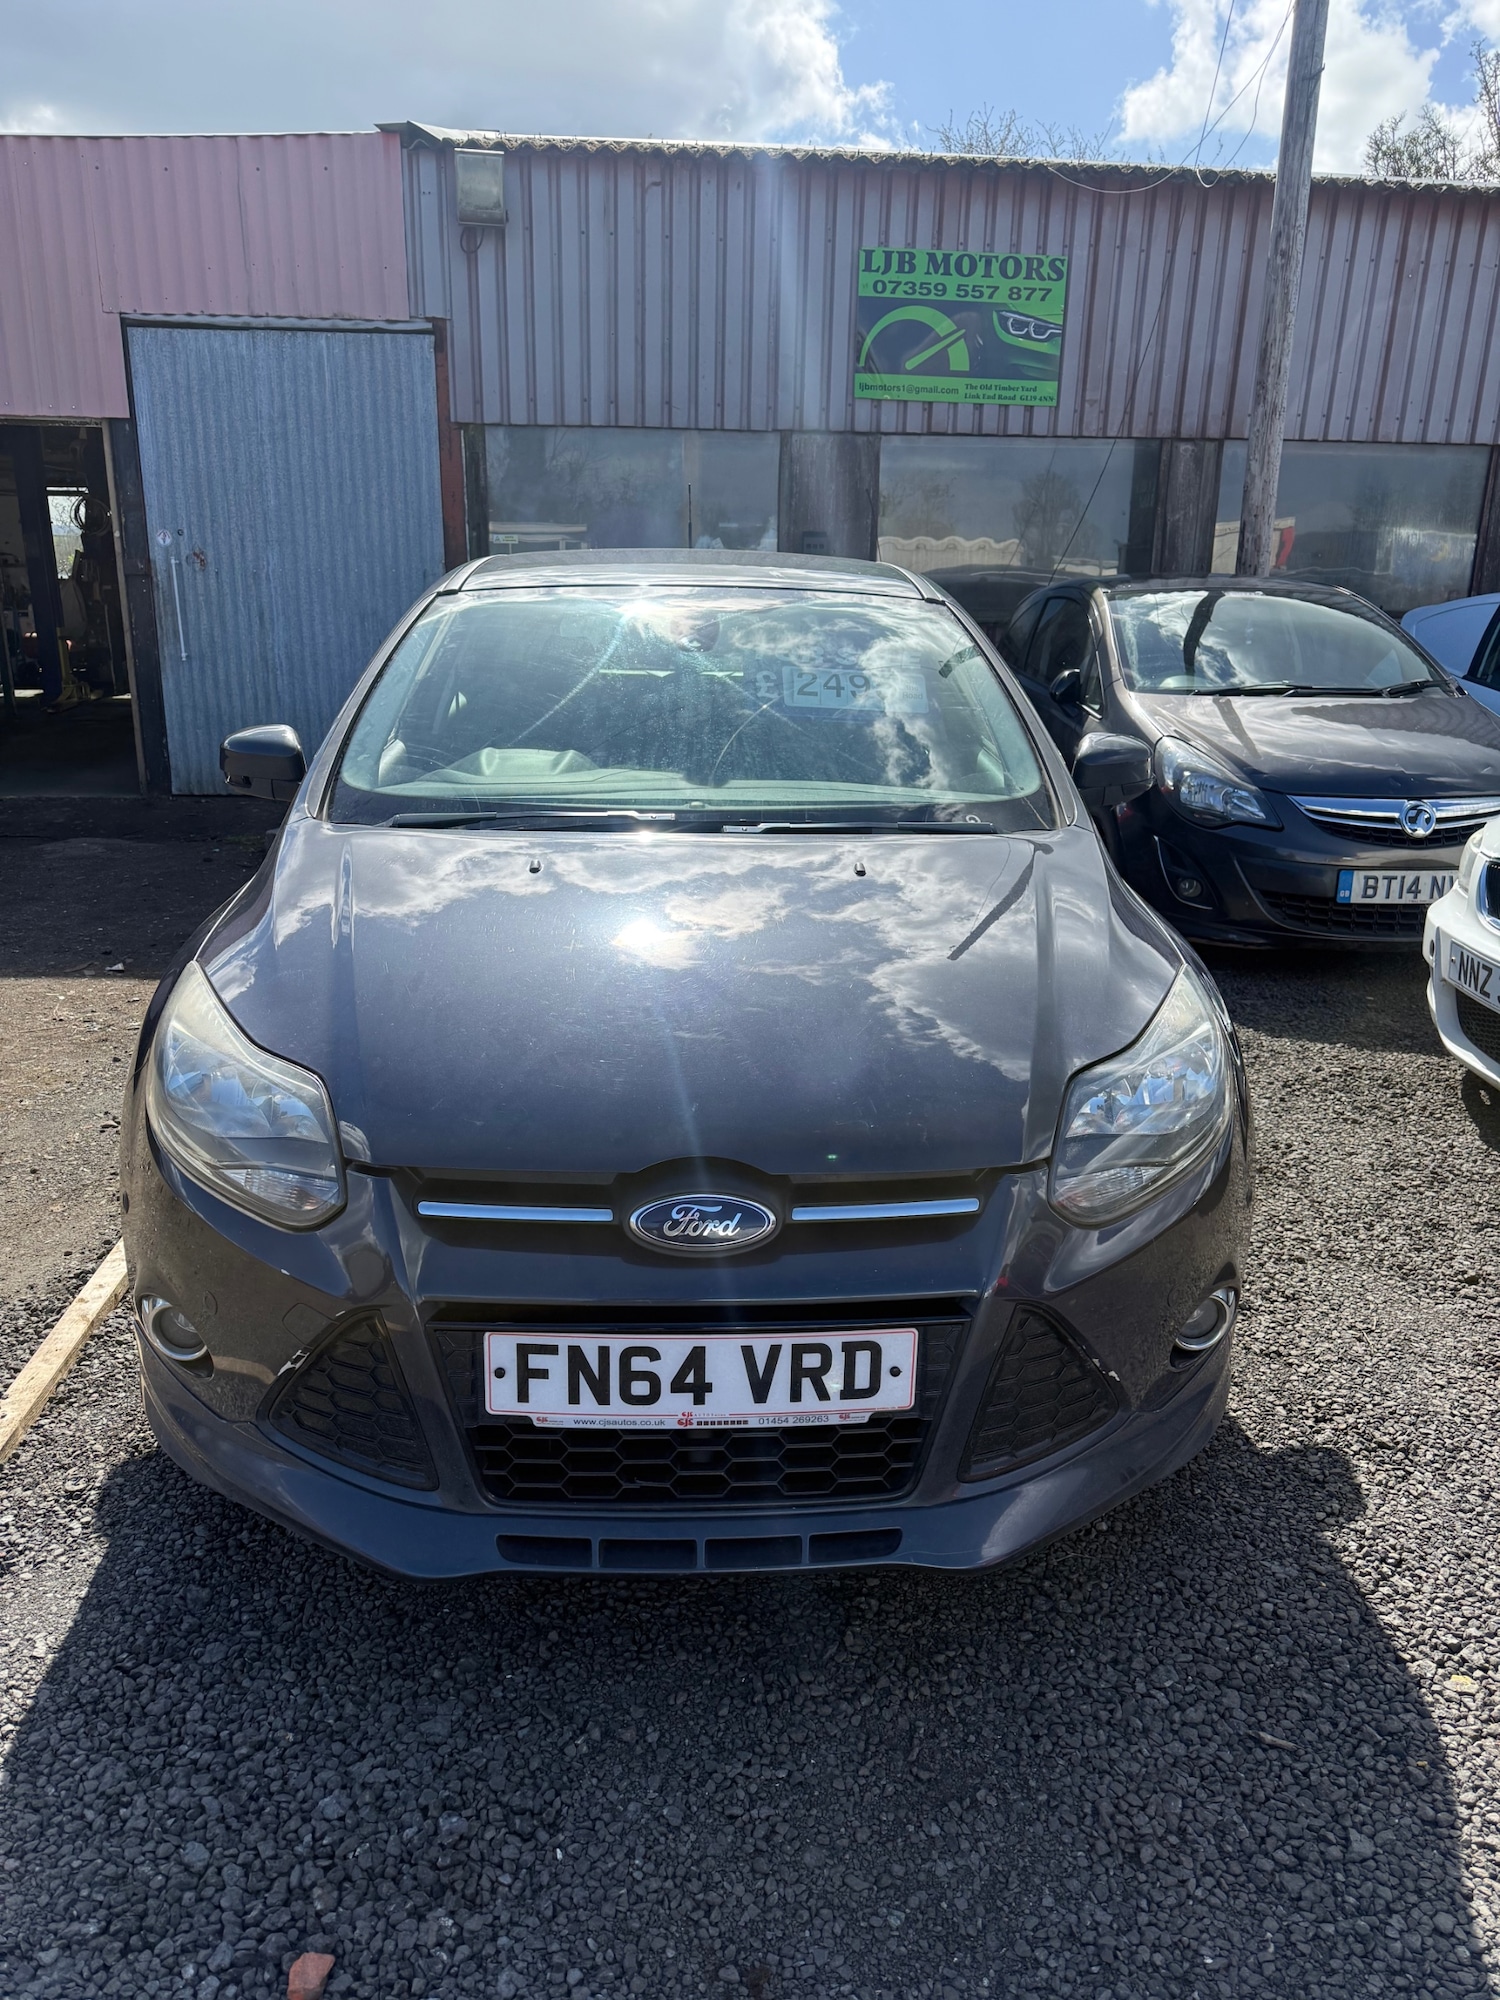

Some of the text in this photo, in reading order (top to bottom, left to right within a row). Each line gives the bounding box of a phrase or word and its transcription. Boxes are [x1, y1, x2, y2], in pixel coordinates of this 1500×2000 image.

[862, 249, 1066, 282] LJB MOTORS
[872, 279, 1053, 302] 07359 557 877
[858, 382, 959, 395] ljbmotors1@gmail.com
[964, 383, 1038, 393] The Old Timber Yard
[964, 392, 981, 400] Link
[1361, 874, 1422, 900] BT14
[1458, 950, 1493, 1000] NNZ
[663, 1204, 742, 1237] Ford
[516, 1340, 883, 1406] FN64 VRD
[573, 1418, 666, 1427] www.cjsautos.co.uk
[758, 1416, 790, 1426] 01454
[792, 1415, 830, 1425] 269263
